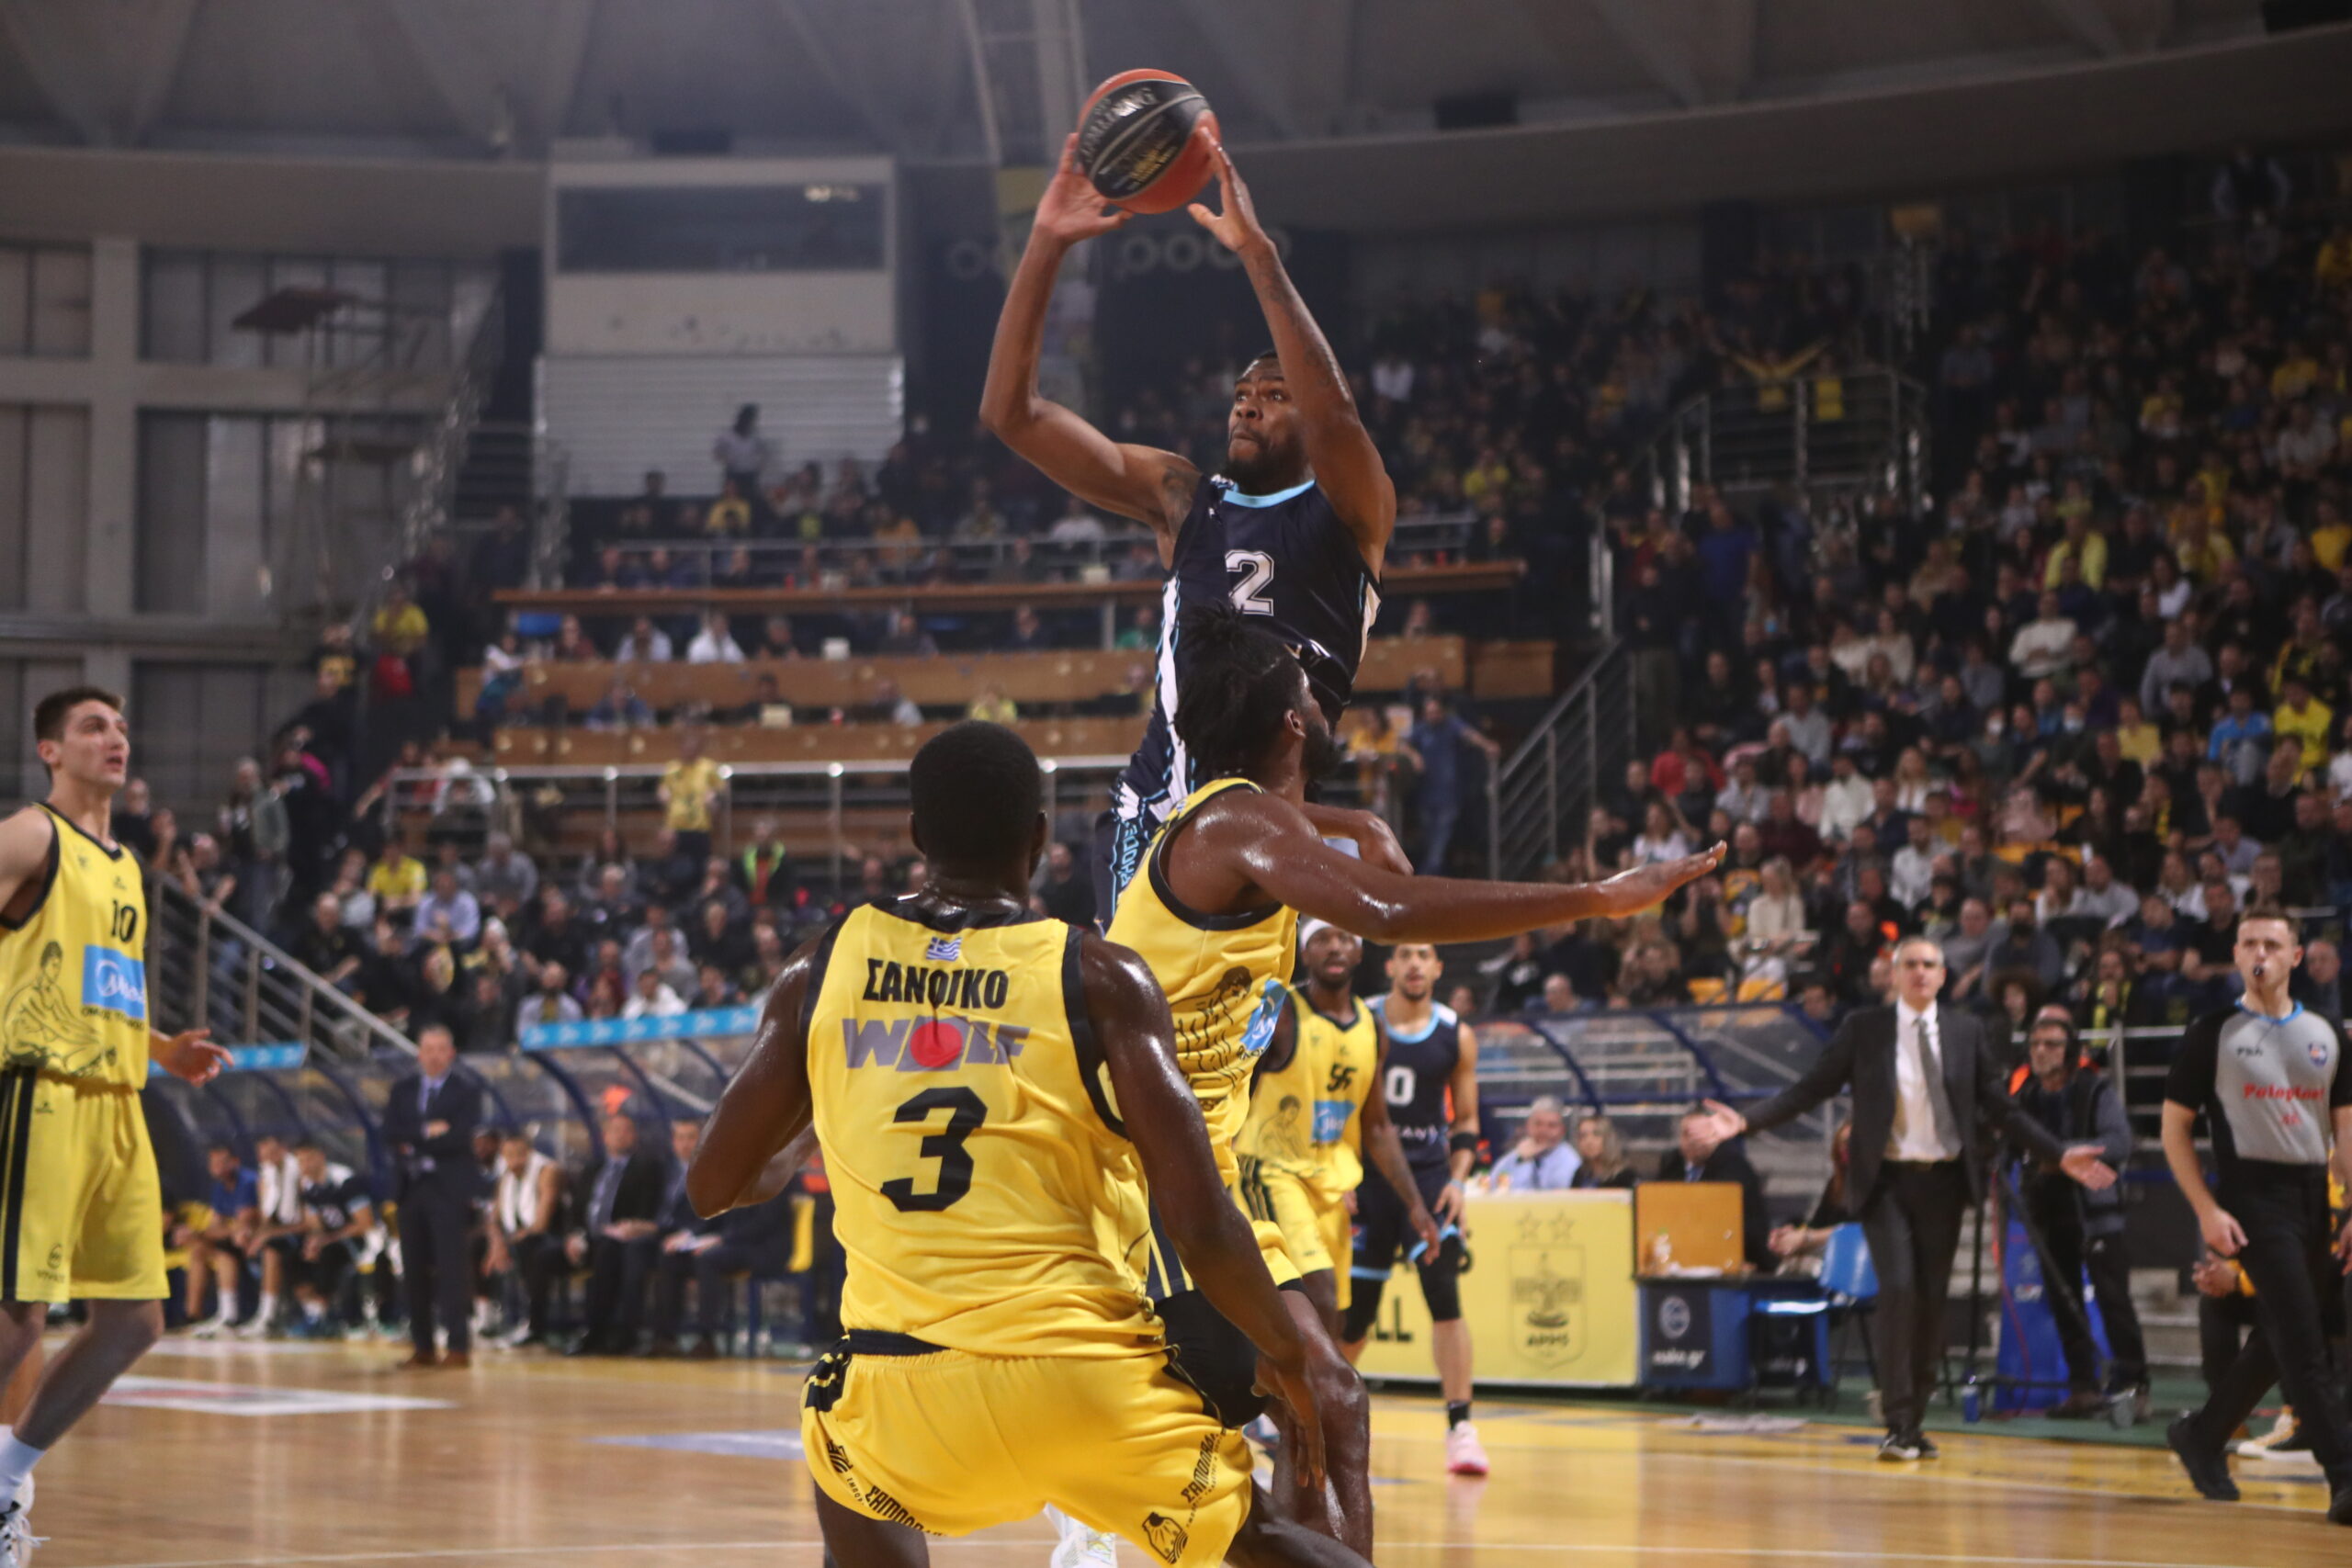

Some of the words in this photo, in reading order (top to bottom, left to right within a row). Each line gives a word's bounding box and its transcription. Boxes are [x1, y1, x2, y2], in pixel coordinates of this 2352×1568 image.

[1225, 549, 1274, 616] 2
[111, 899, 137, 942] 10
[842, 1015, 1031, 1072] WOLF
[1385, 1066, 1416, 1107] 0
[880, 1086, 989, 1213] 3
